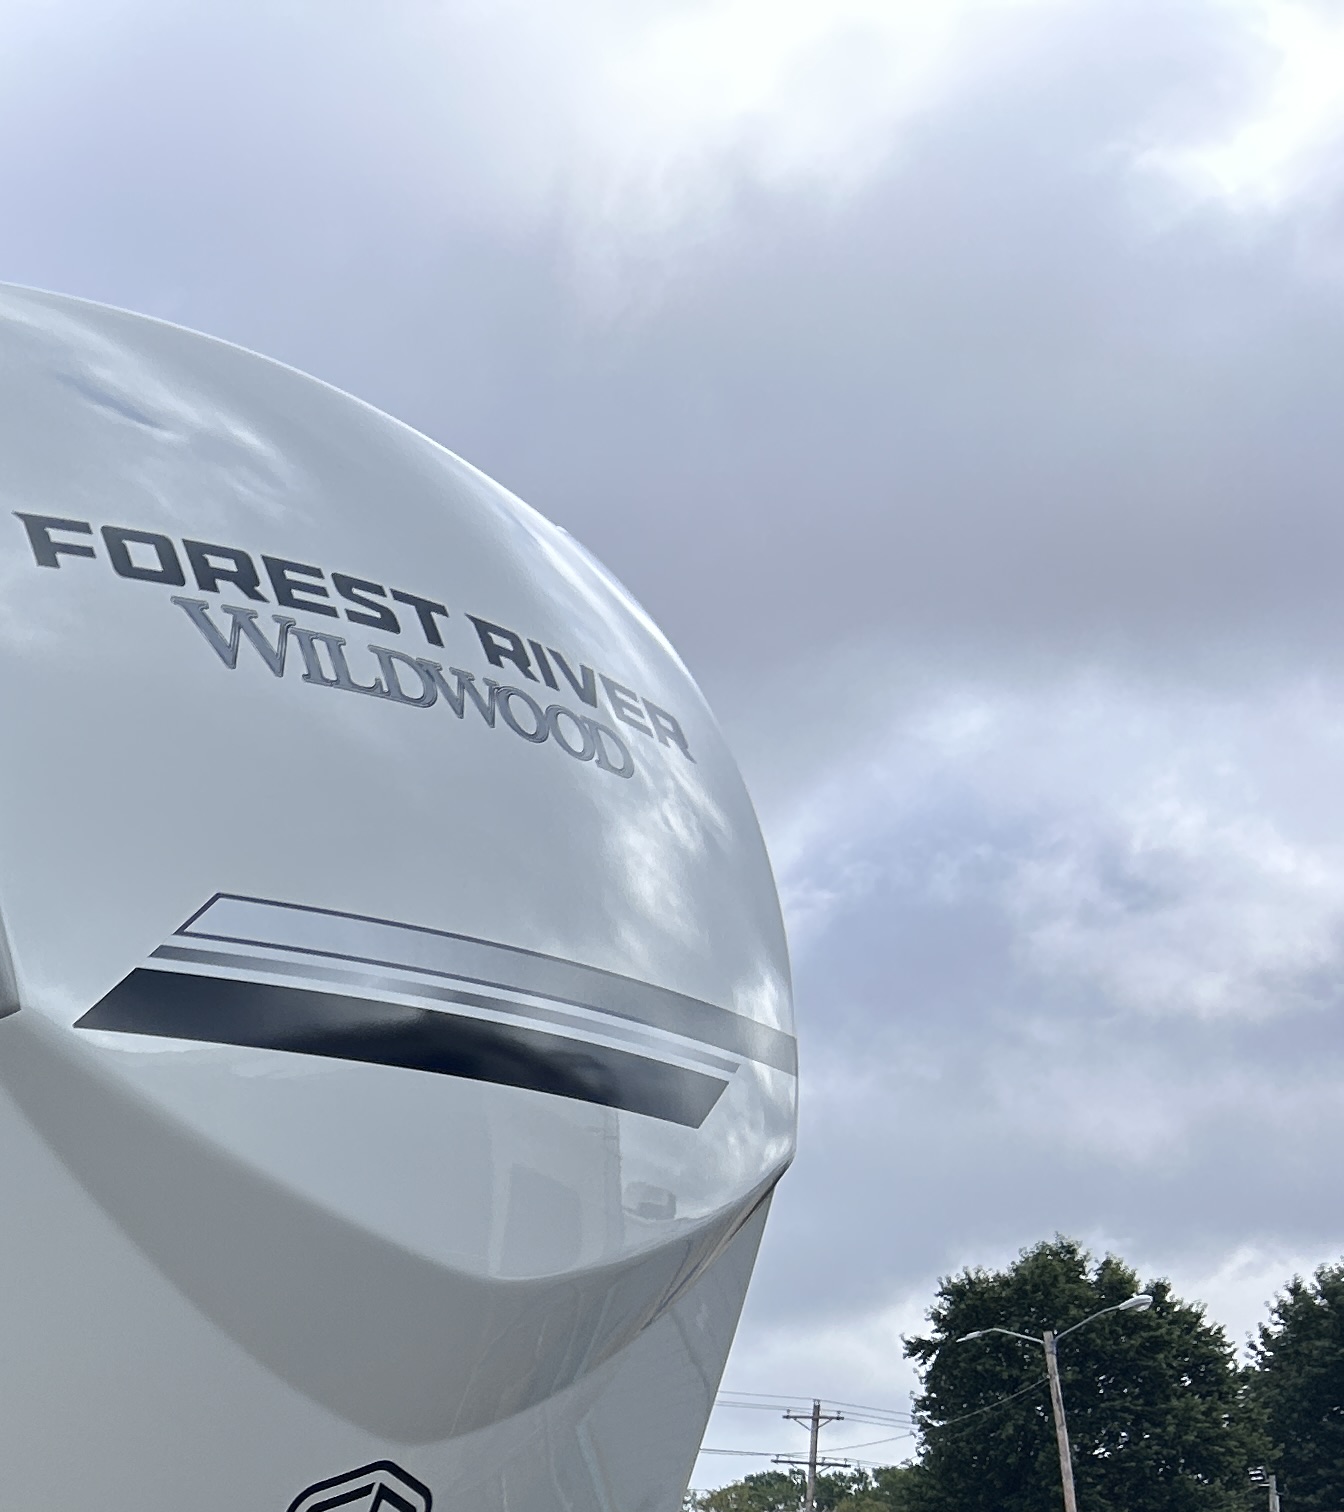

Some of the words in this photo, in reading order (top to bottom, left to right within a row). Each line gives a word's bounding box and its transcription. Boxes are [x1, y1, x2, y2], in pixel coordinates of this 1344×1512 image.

[10, 510, 450, 648] FOREST
[465, 613, 699, 764] RIVER
[169, 595, 636, 780] WILDWOOD
